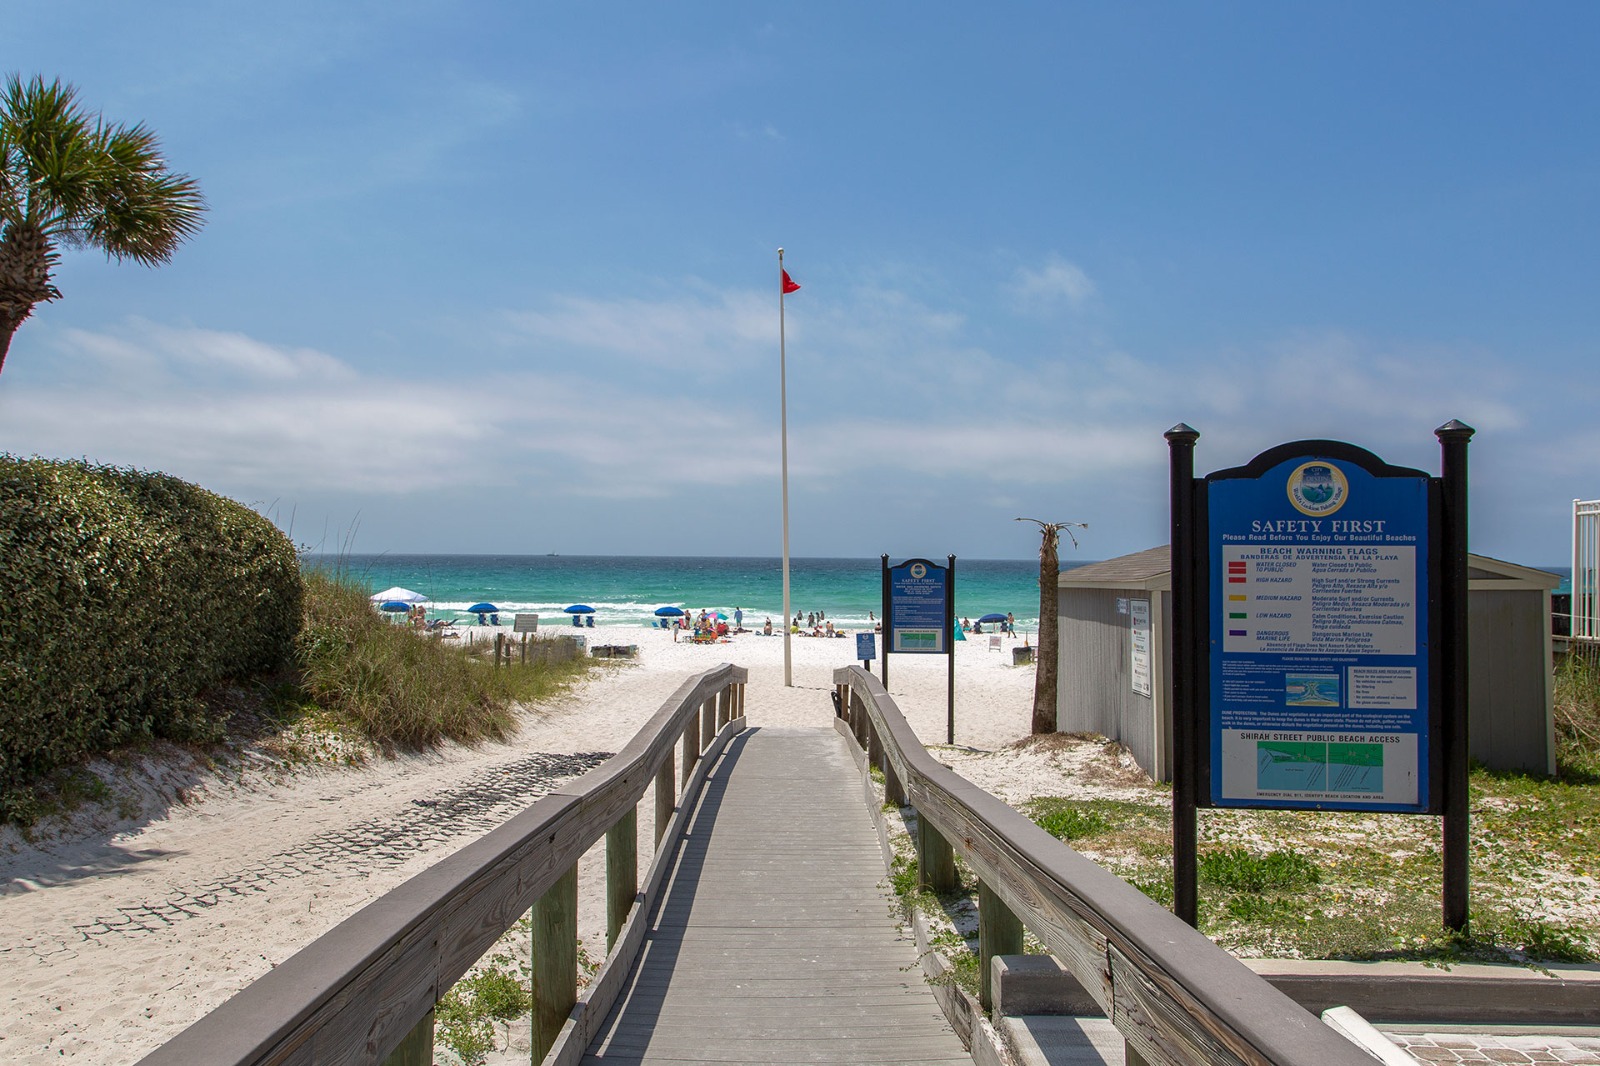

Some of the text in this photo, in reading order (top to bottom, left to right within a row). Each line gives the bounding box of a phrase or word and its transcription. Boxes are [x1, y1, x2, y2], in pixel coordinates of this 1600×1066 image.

[1252, 520, 1386, 533] SAFETY FIRST
[1312, 534, 1331, 542] Enjoy
